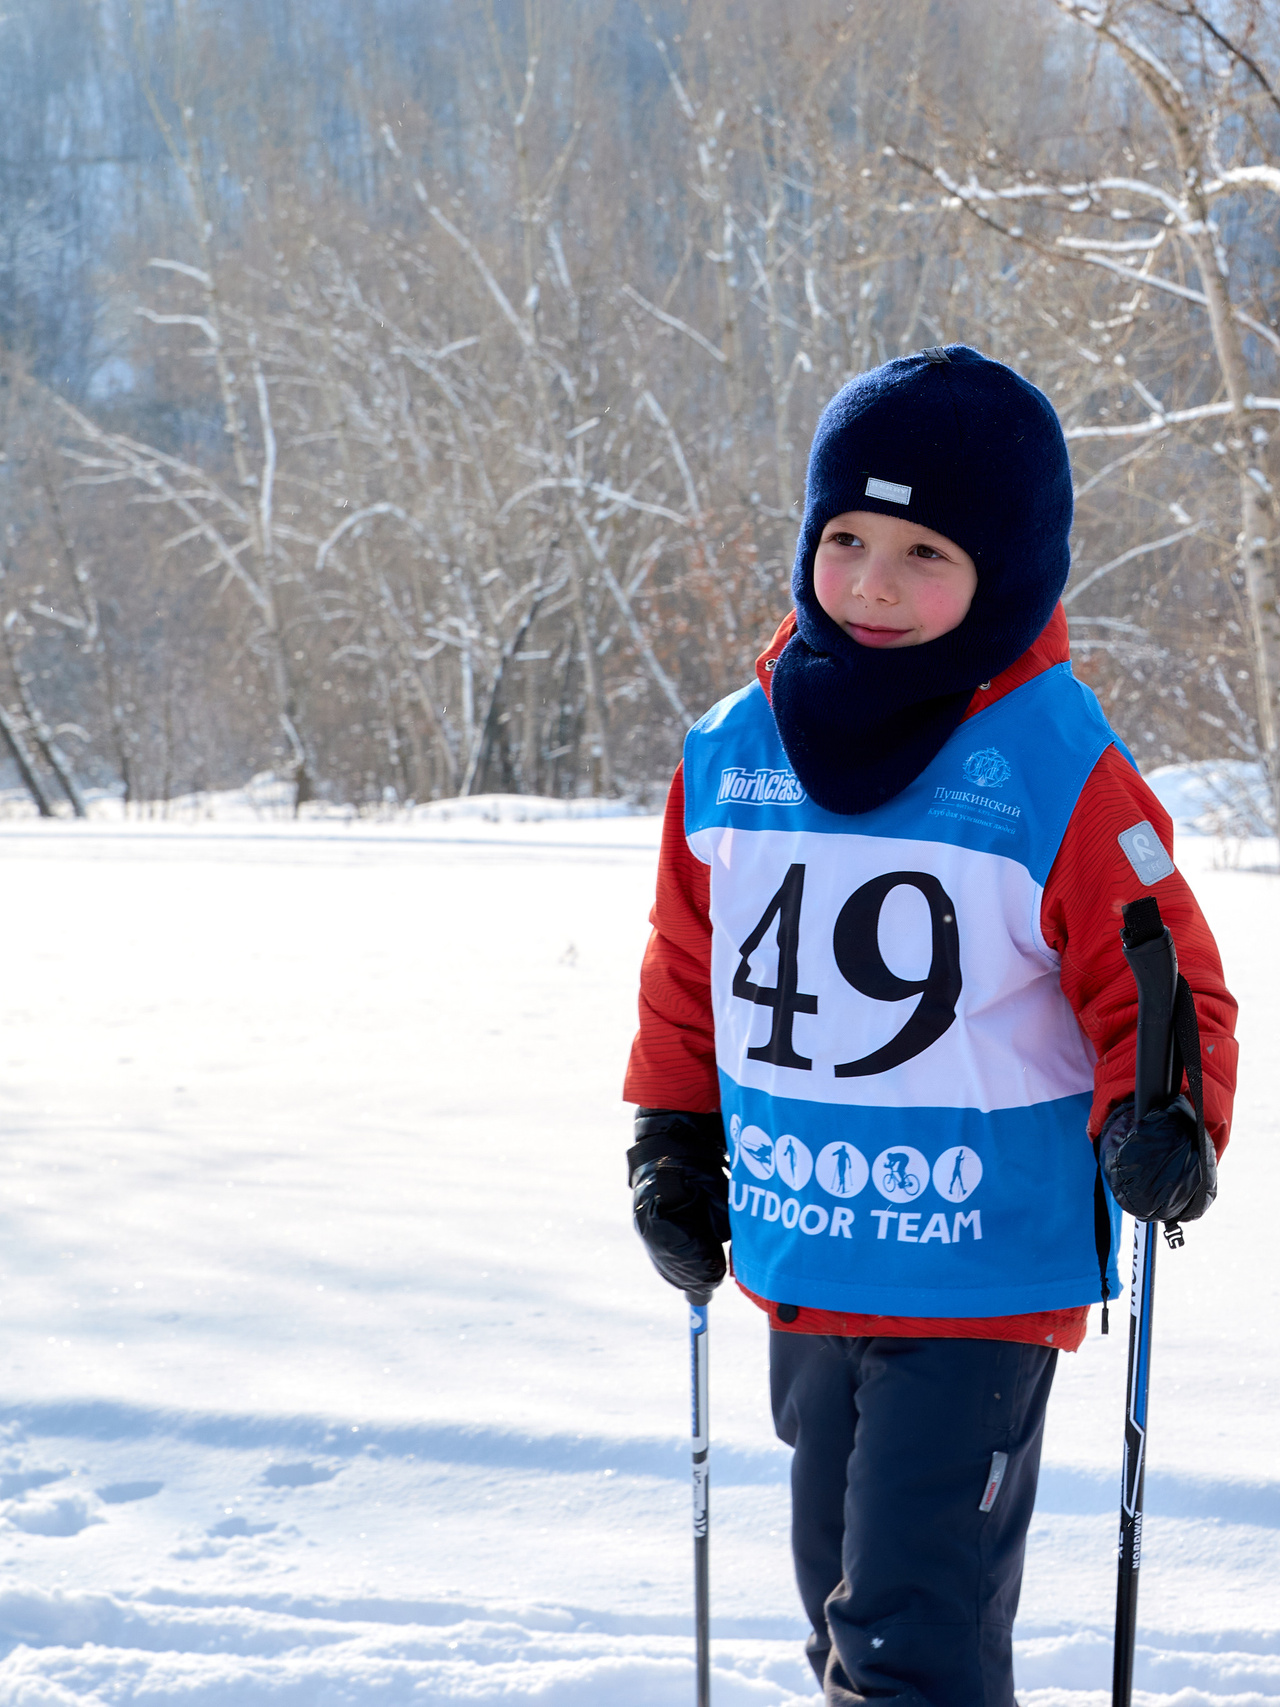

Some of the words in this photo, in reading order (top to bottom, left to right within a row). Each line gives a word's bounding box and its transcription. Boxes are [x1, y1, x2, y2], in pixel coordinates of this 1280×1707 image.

[763, 773, 804, 802] Class
[934, 787, 1021, 818] Пушкинский
[927, 807, 945, 818] Клуб
[1146, 859, 1165, 874] TEC
[732, 863, 963, 1079] 49
[728, 1180, 856, 1240] UTDOOR
[870, 1205, 984, 1245] TEAM
[1131, 1510, 1143, 1570] NORDWAY
